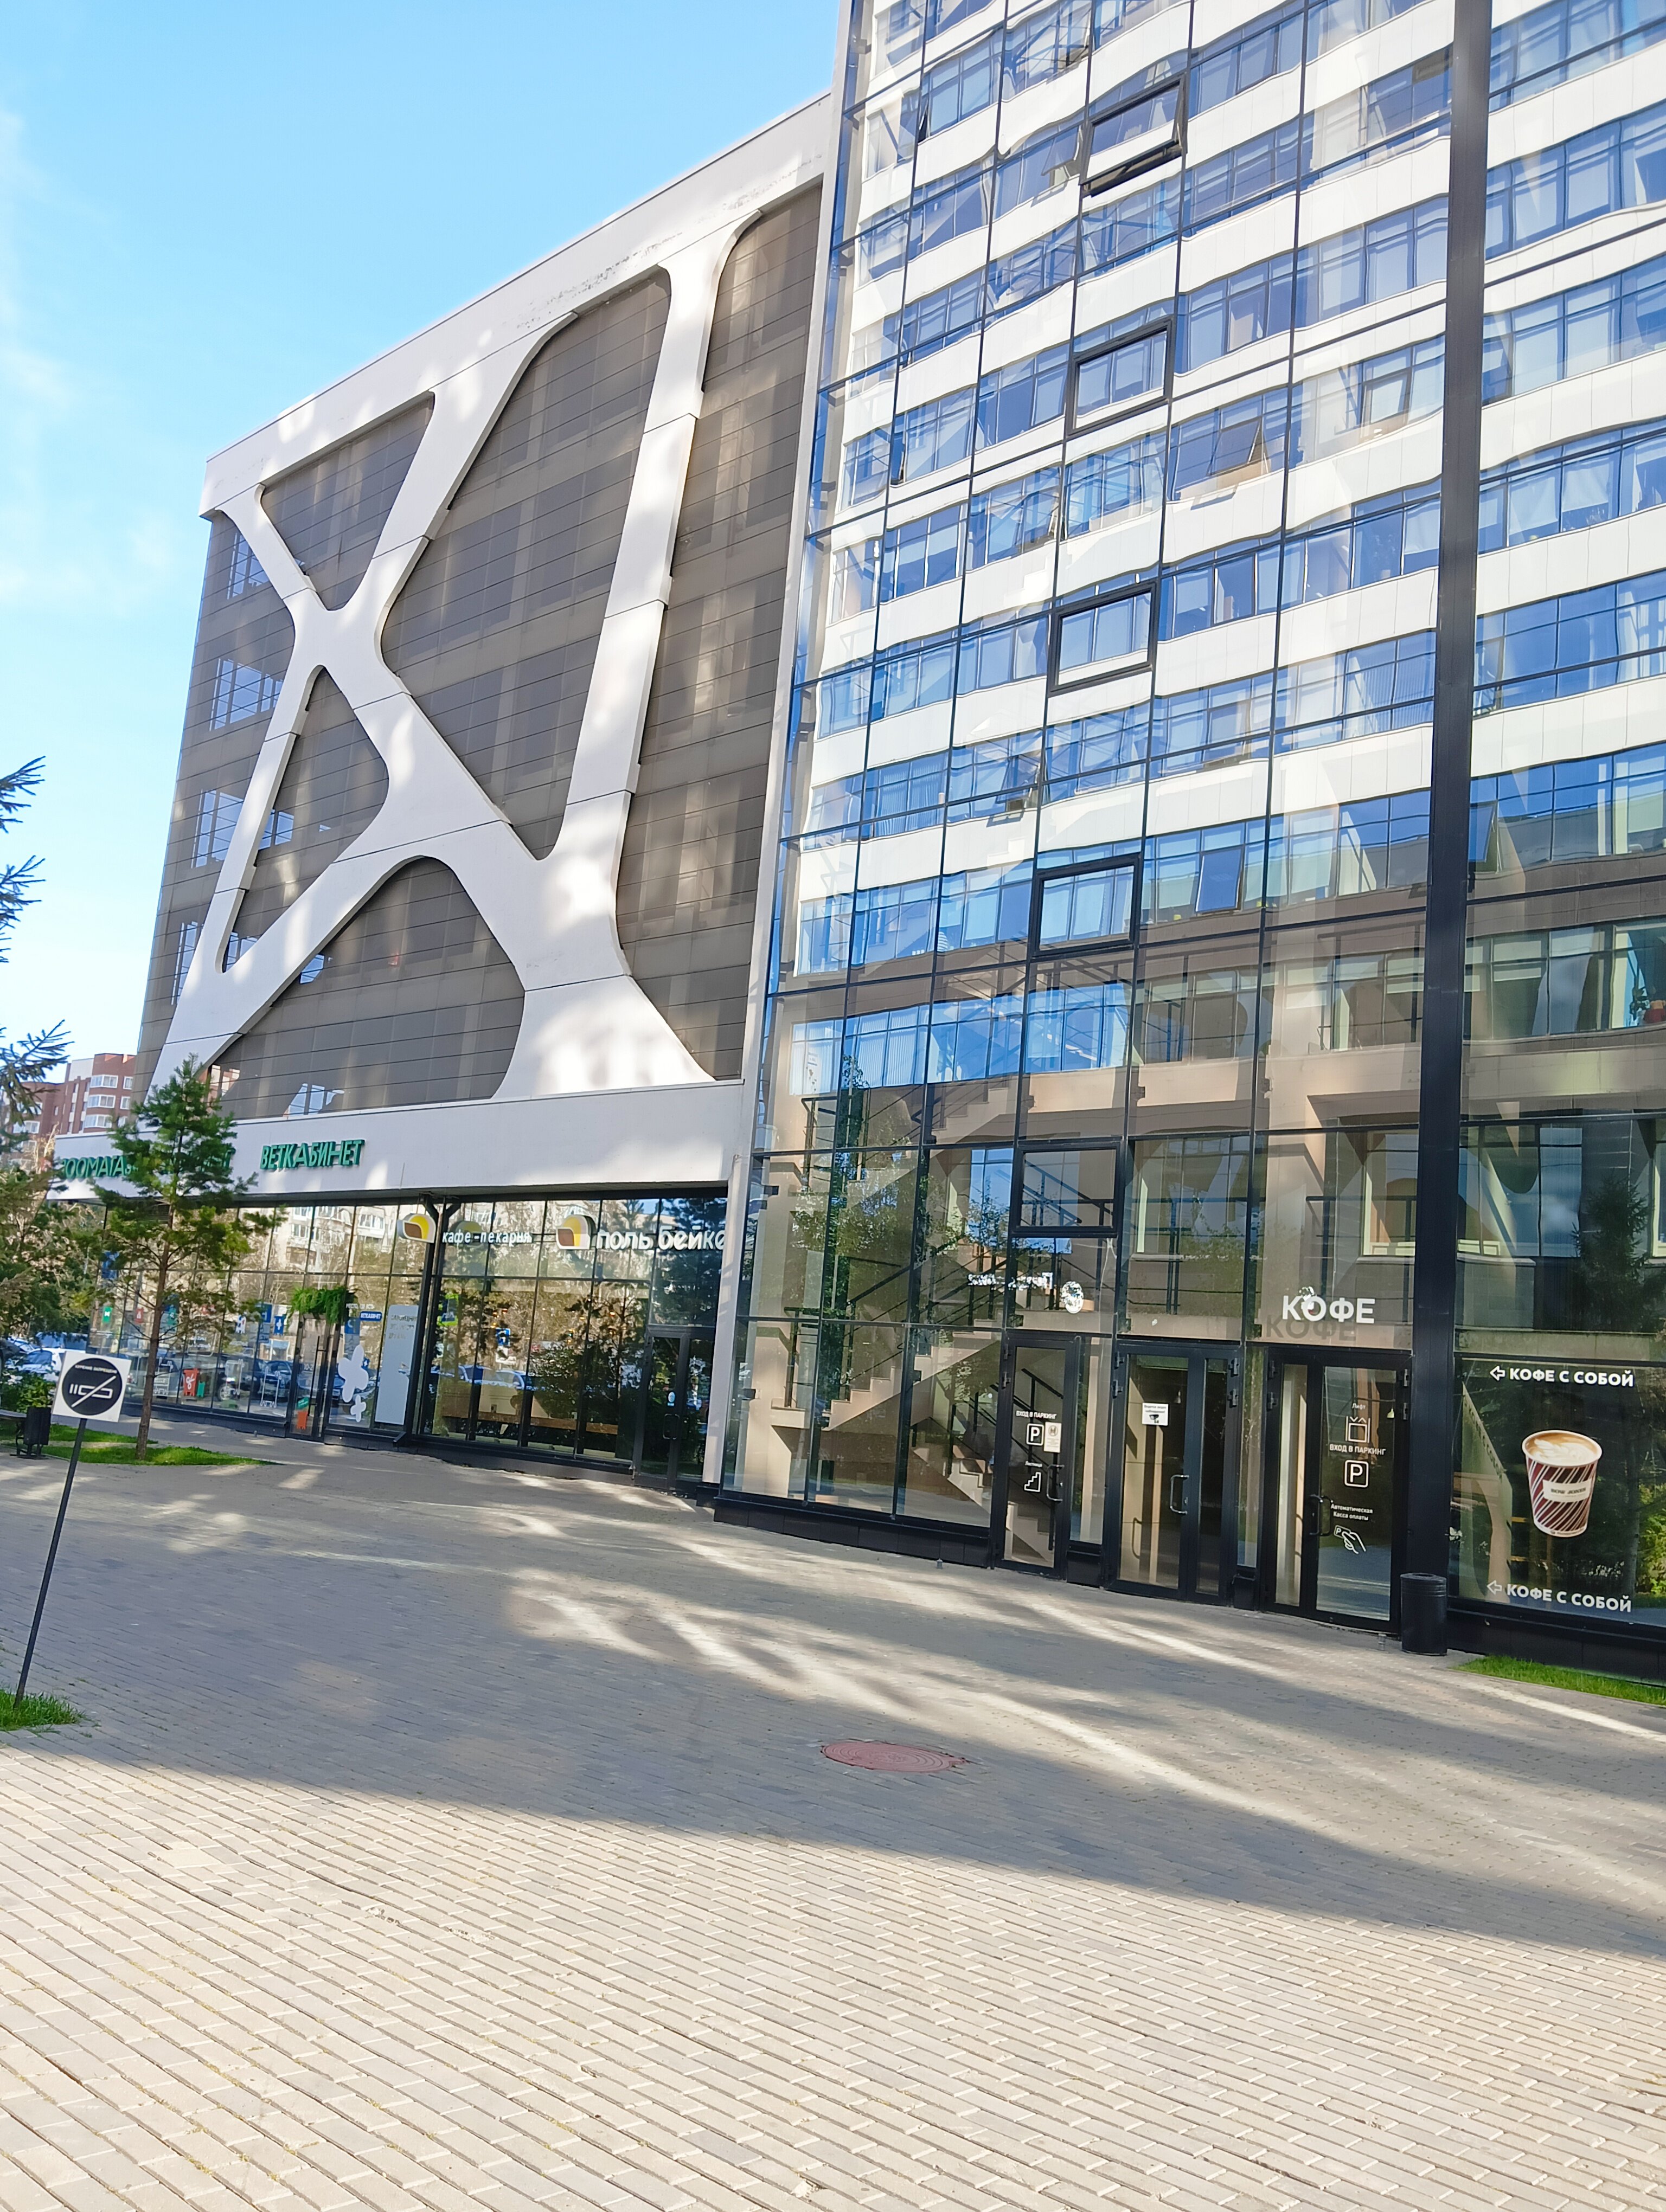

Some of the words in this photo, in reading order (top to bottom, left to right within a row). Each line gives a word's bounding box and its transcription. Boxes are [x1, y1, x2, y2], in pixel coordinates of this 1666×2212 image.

[260, 1139, 365, 1169] ВЕТКАБИНЕТ
[596, 1231, 653, 1250] поль
[1282, 1295, 1375, 1324] КОФЕ
[1510, 1368, 1555, 1382] КОФЕ
[1559, 1371, 1569, 1382] С
[1574, 1370, 1633, 1387] СОБОЙ
[1329, 1444, 1348, 1452] ВХОД
[1354, 1446, 1386, 1455] ПАРКИНГ
[1350, 1464, 1363, 1483] P
[1330, 1503, 1373, 1514] Автоматическая
[1507, 1584, 1552, 1602] КОФЕ
[1556, 1591, 1567, 1604] С
[1571, 1593, 1631, 1612] СОБОЙ
